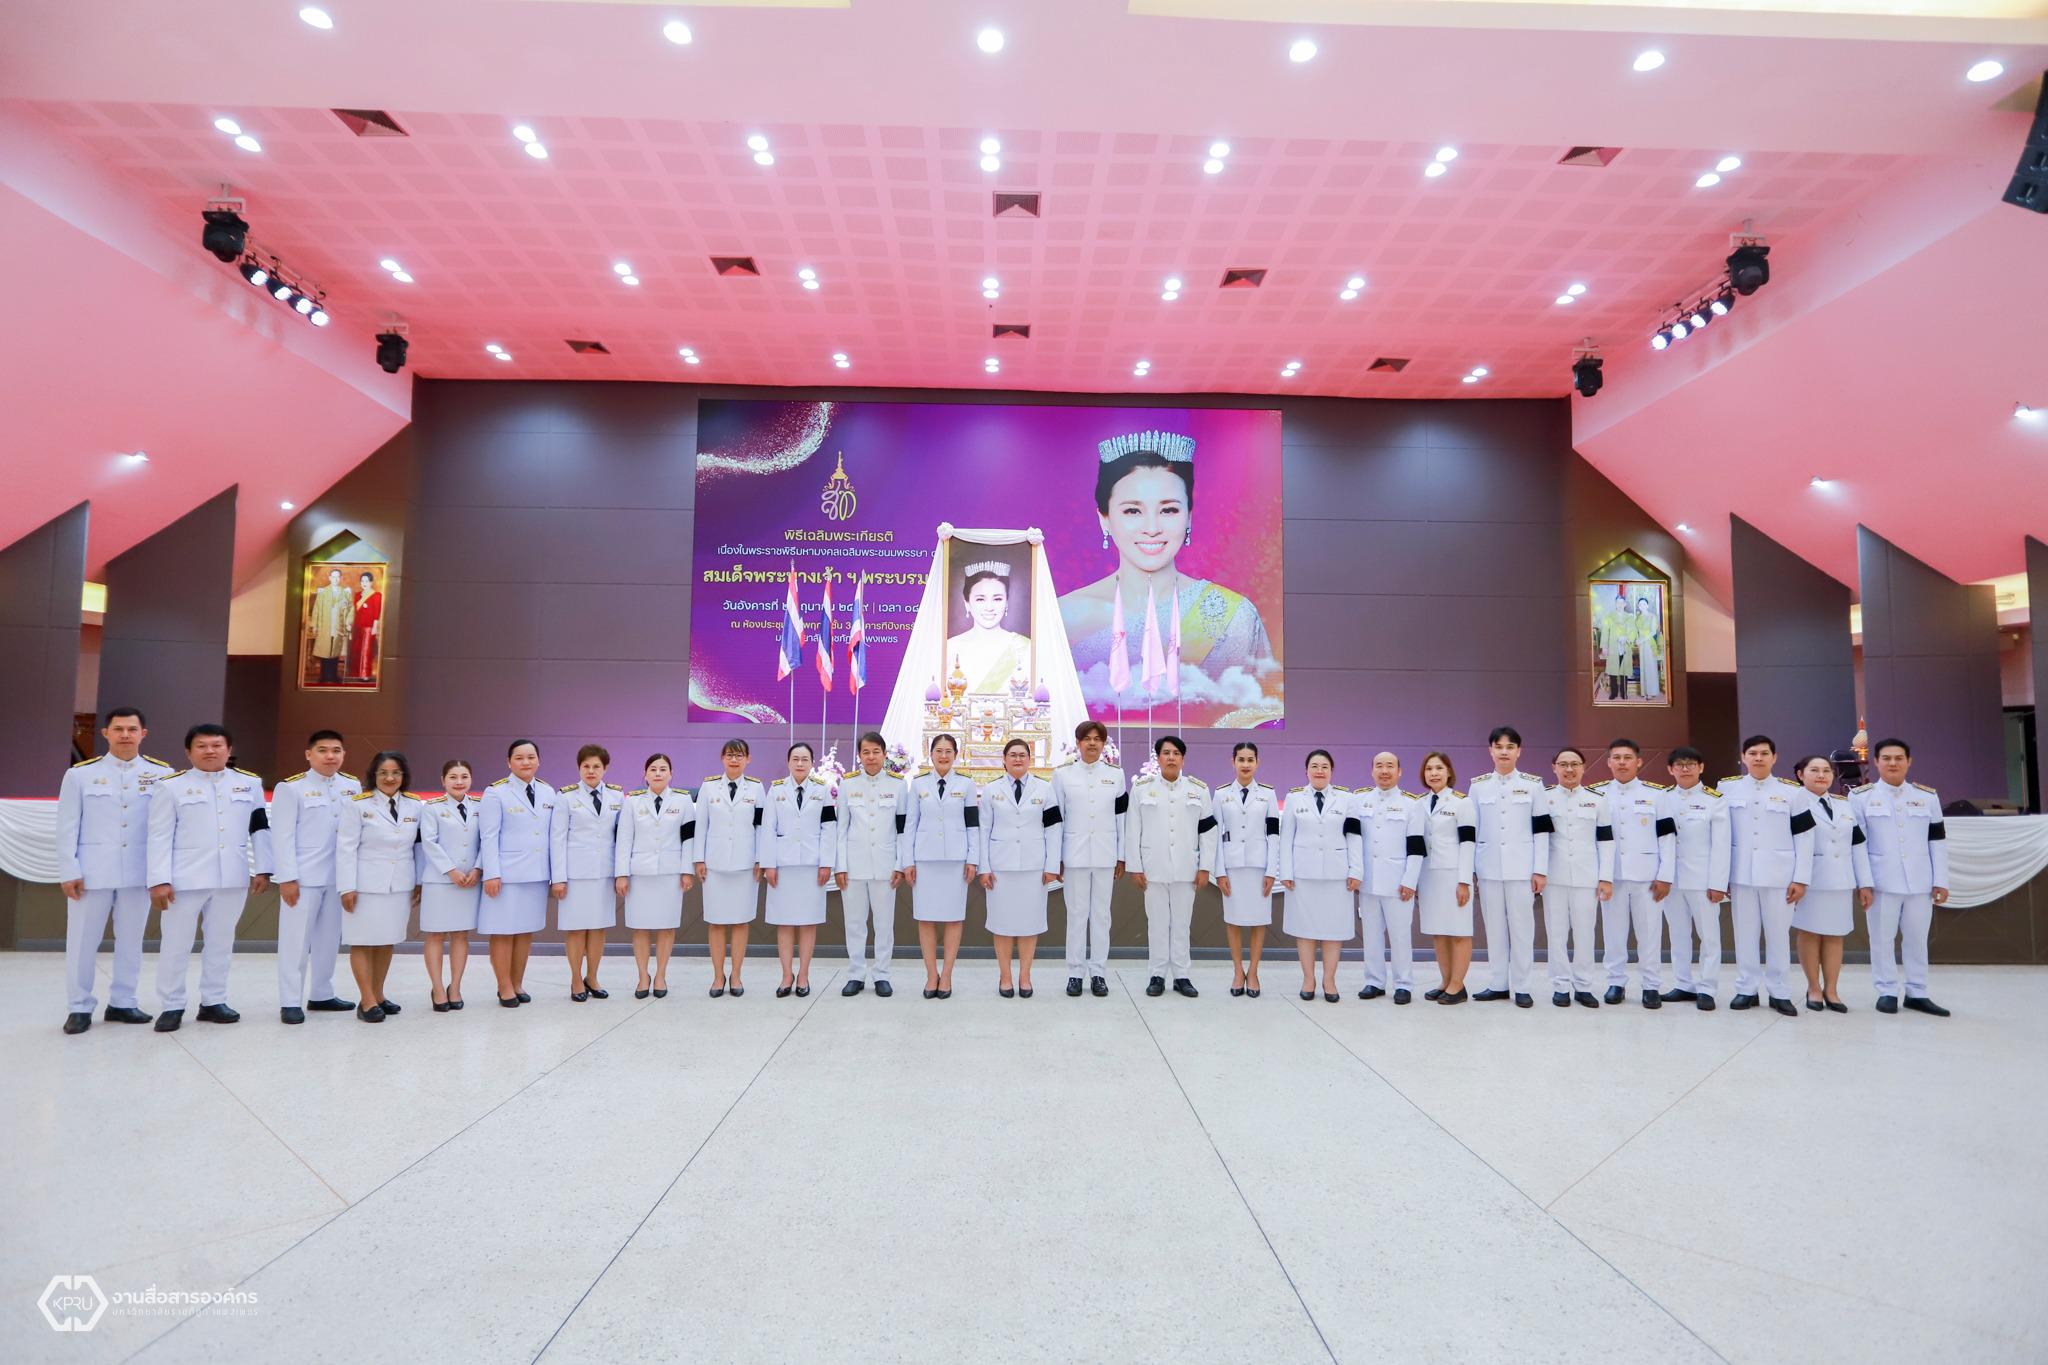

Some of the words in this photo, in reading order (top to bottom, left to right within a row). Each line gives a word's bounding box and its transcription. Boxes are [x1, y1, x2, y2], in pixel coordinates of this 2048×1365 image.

[784, 529, 893, 543] พิธีเฉลิมพระเกียรติ
[717, 543, 928, 558] เนื่องในพระราชพิธีมหามงคลเฉลิมพระชนมพรรษา
[863, 572, 928, 585] พระบรม
[722, 598, 779, 611] วันอังคารที่
[878, 603, 901, 613] เวลา
[904, 604, 919, 613] ๐๘
[730, 620, 740, 629] ณ
